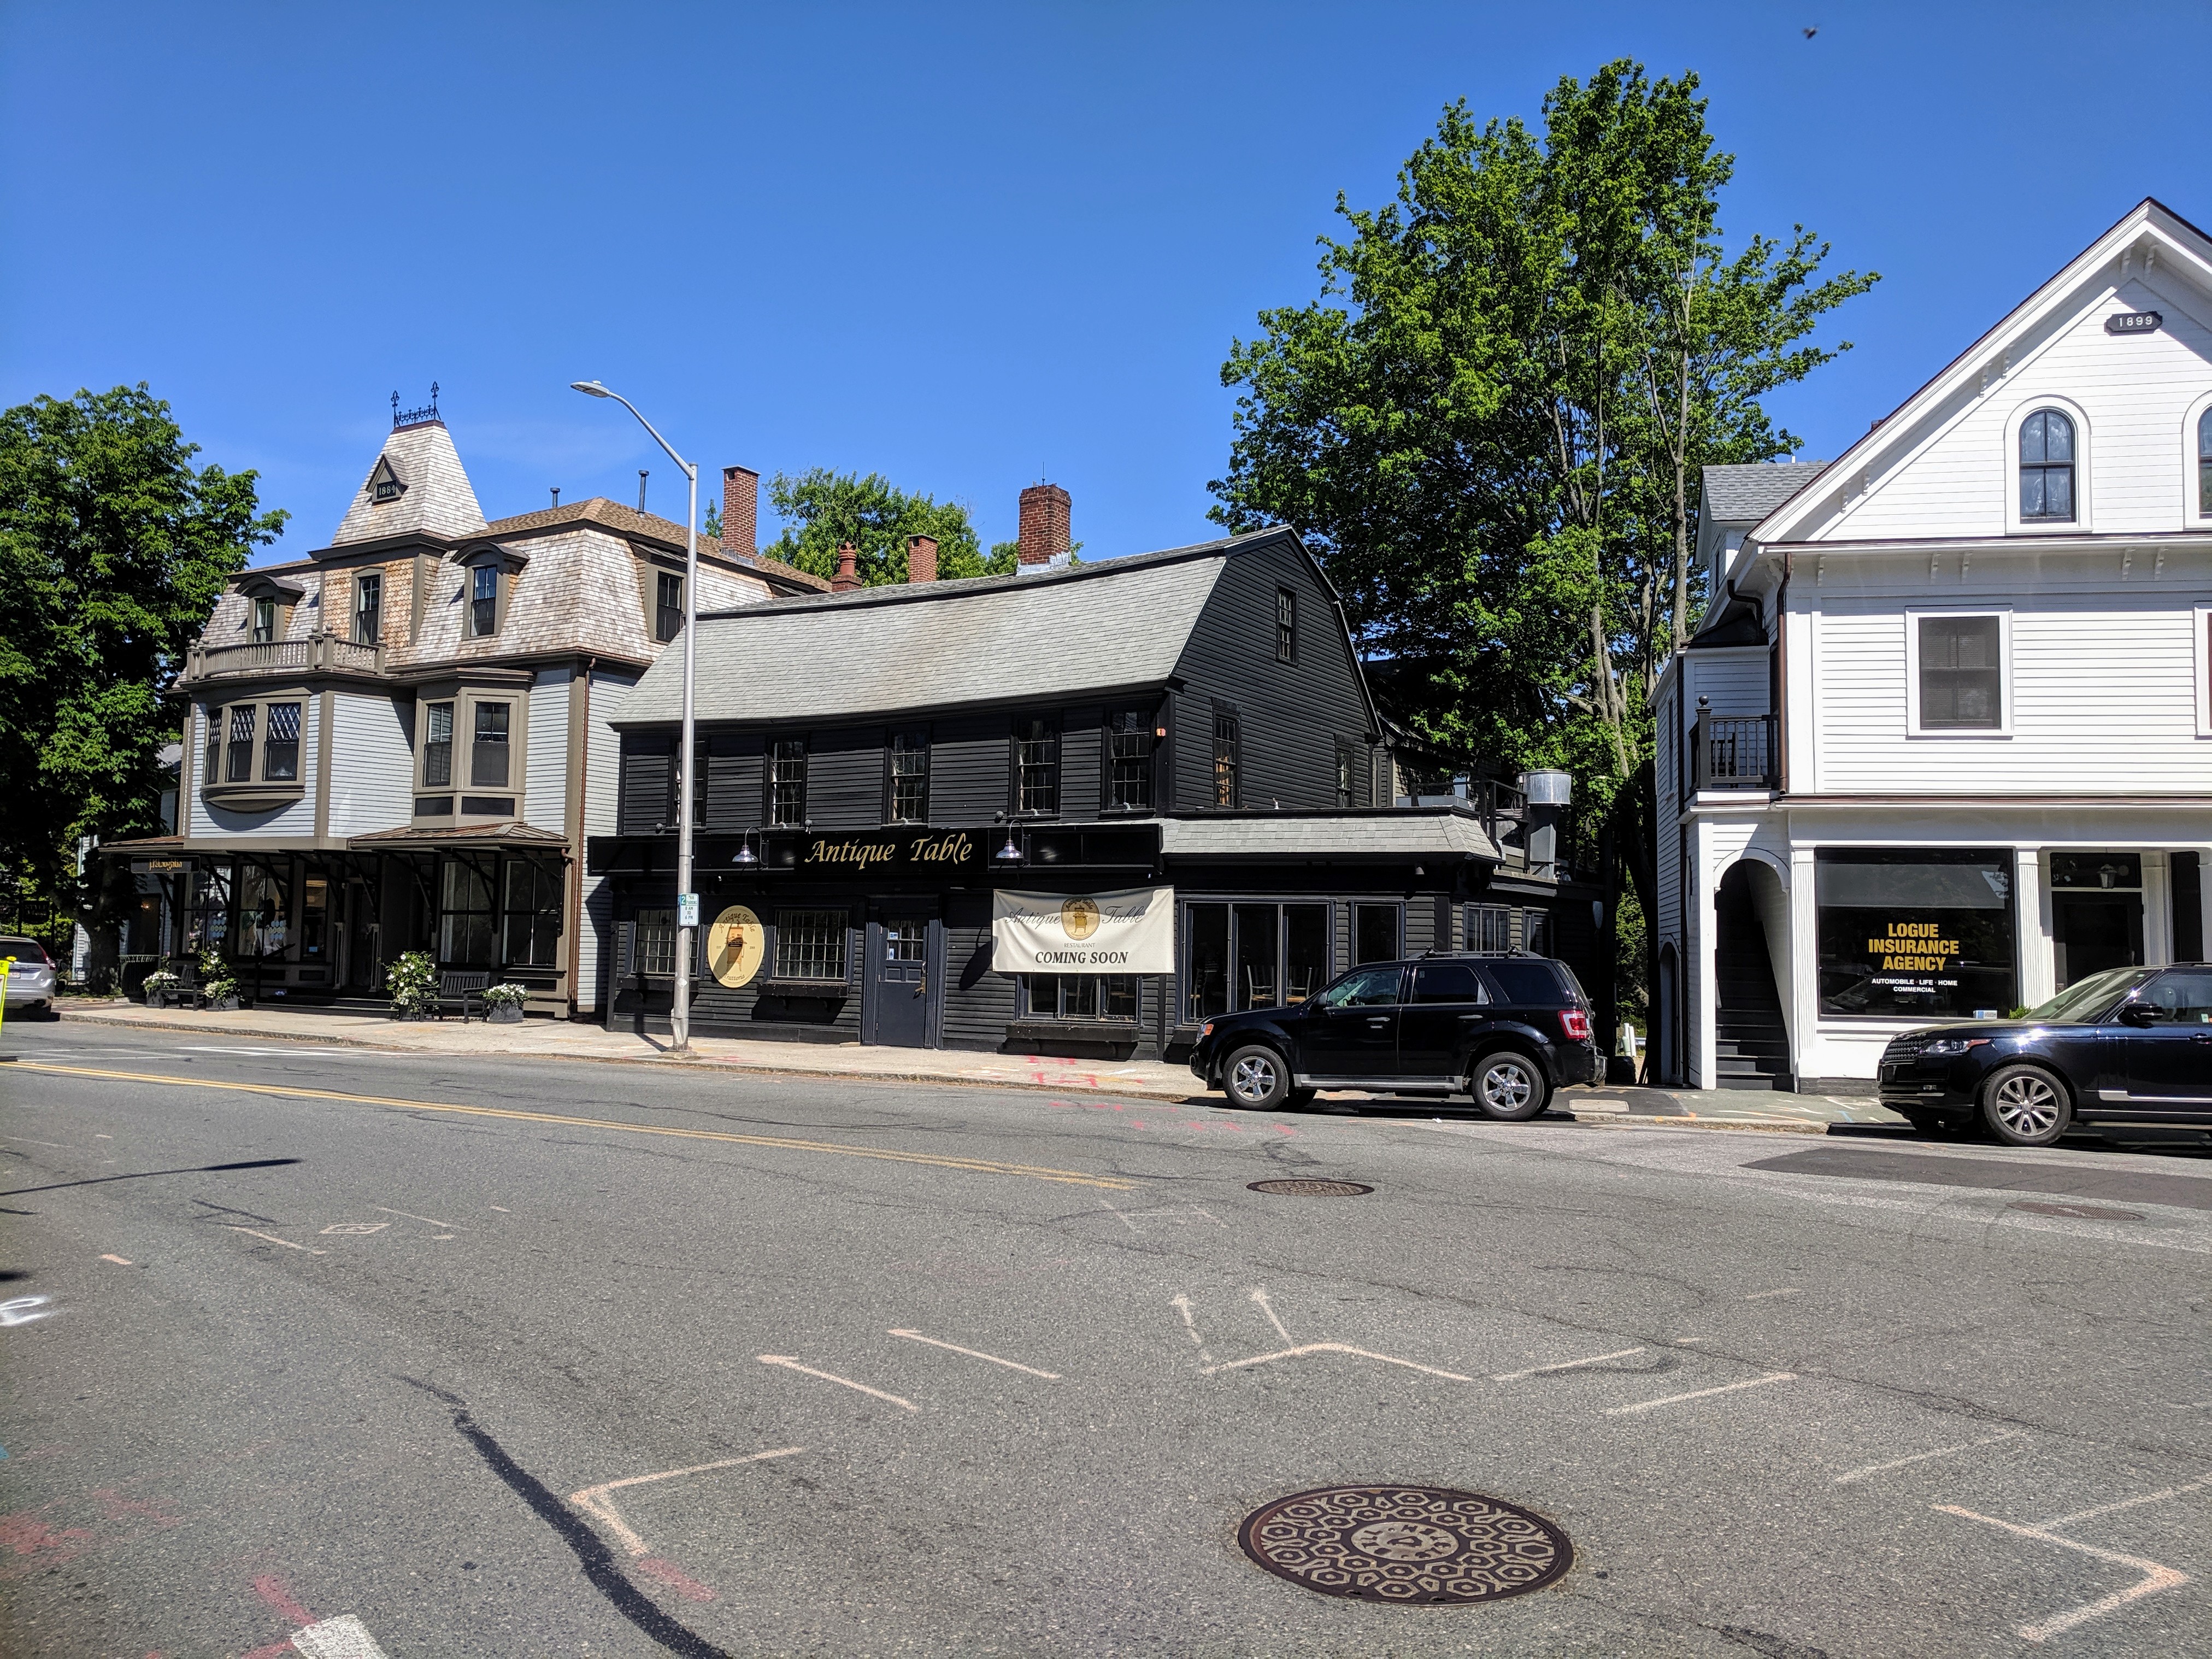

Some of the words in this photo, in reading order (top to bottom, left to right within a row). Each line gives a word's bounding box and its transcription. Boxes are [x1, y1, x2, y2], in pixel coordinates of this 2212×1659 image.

[2119, 316, 2153, 327] 1899
[378, 484, 397, 496] 1884
[804, 838, 896, 870] Antique
[910, 833, 973, 864] Table
[681, 896, 686, 904] 2
[719, 913, 742, 933] Antique
[742, 913, 757, 933] Table
[1005, 907, 1061, 929] Antique
[1102, 905, 1144, 924] Table
[1888, 923, 1939, 938] LOGUE
[1868, 939, 1960, 955] INSURANCE
[1035, 951, 1086, 963] COMING
[1090, 952, 1128, 964] SOON
[1882, 956, 1946, 971] AGENCY
